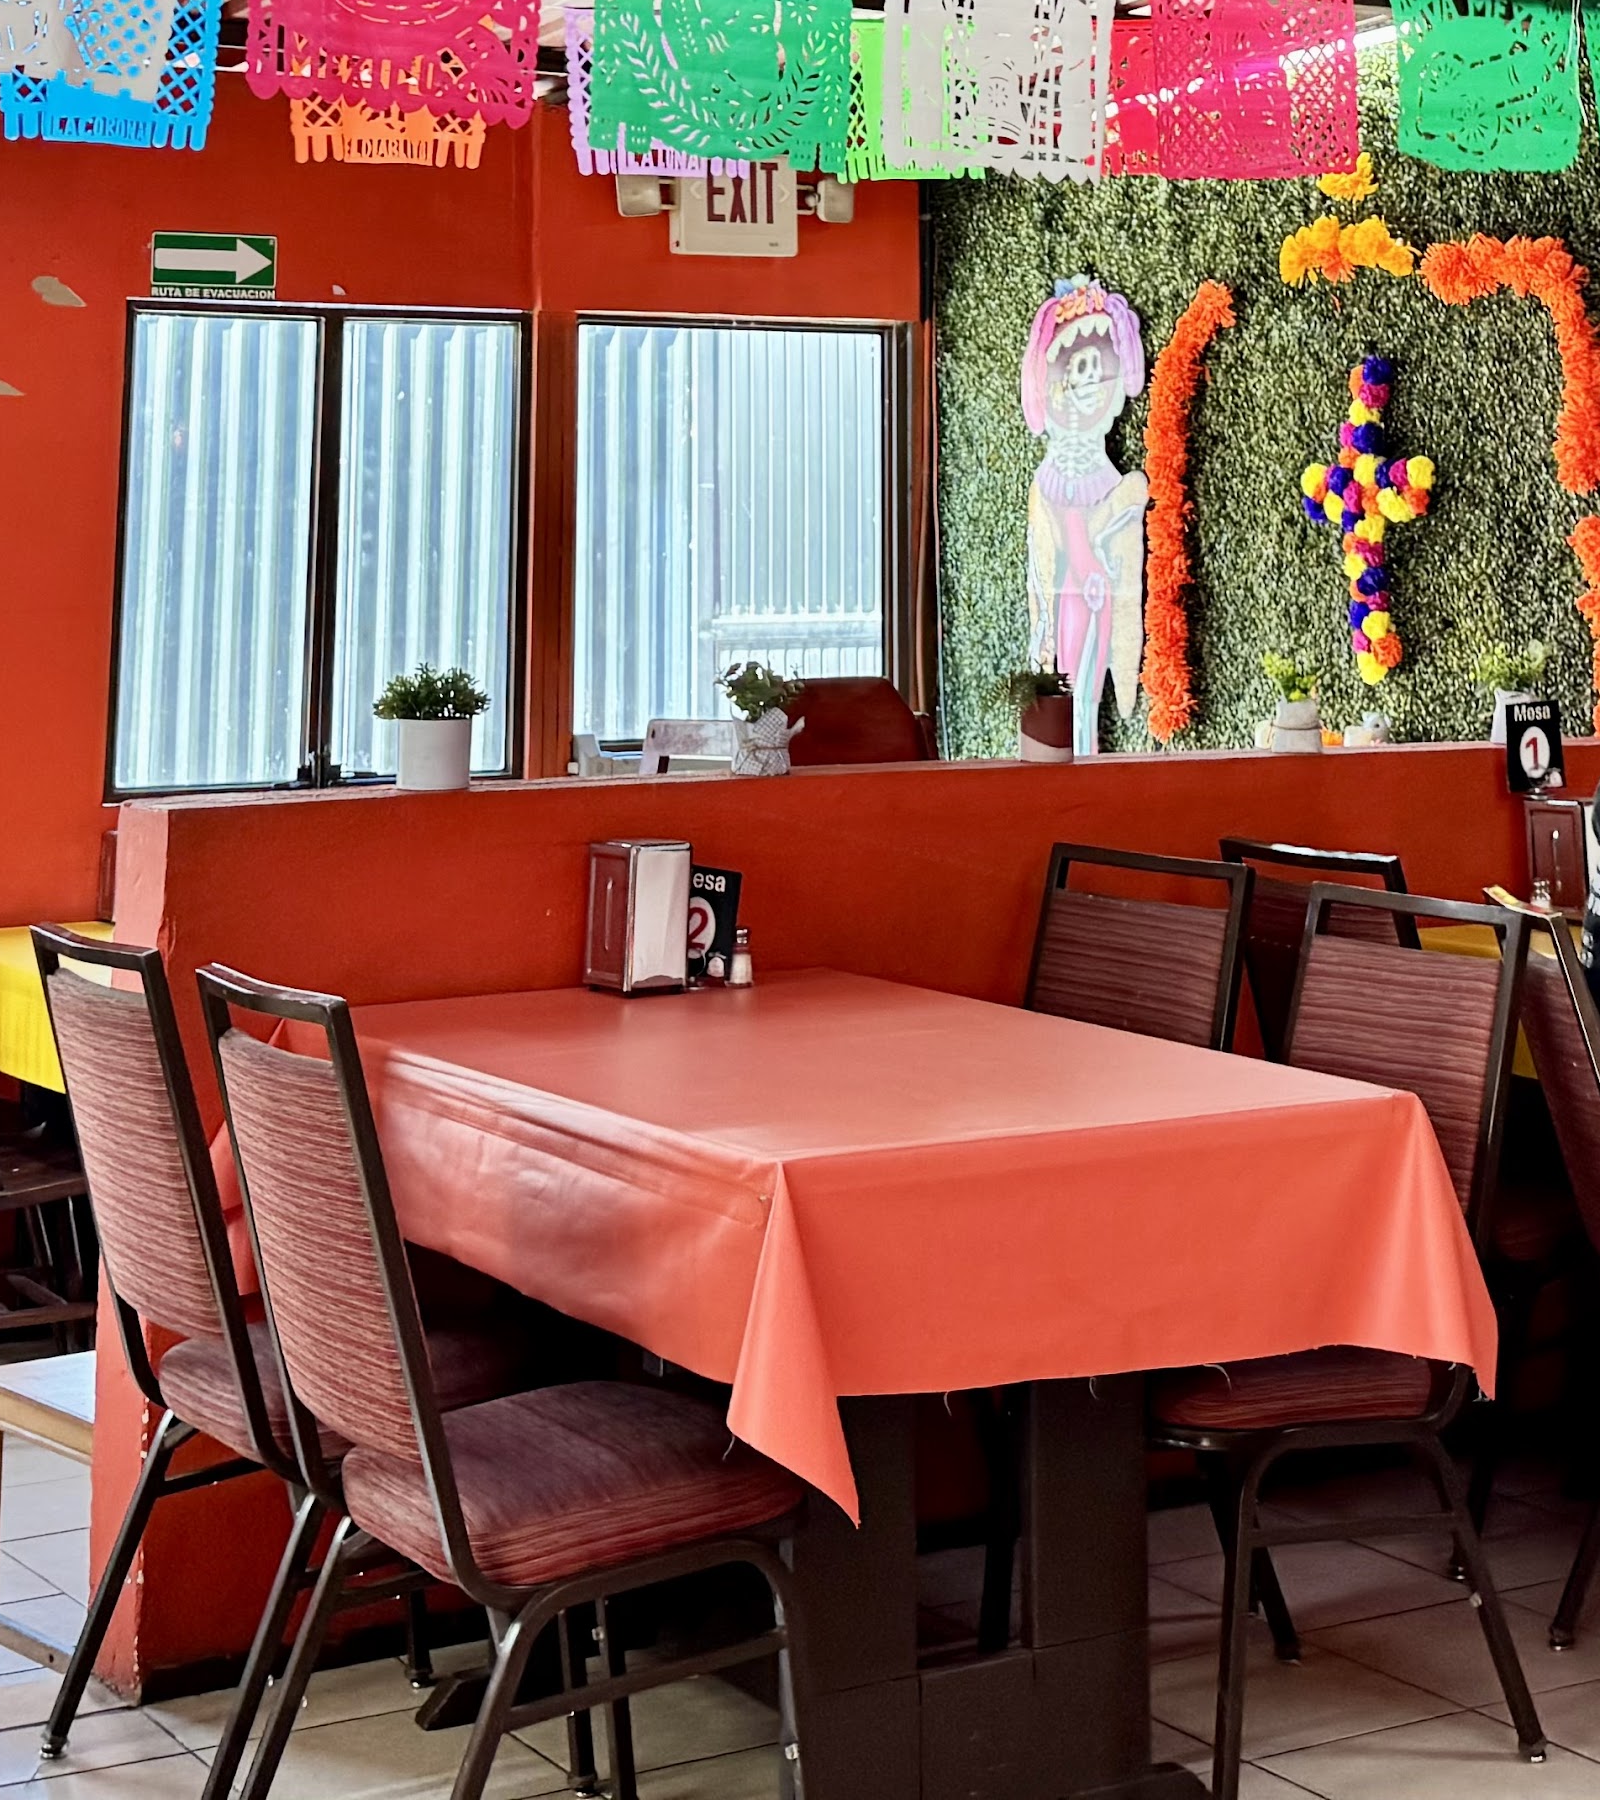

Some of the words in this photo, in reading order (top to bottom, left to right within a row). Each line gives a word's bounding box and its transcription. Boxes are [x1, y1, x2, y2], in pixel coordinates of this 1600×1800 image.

[53, 117, 81, 137] LA
[82, 116, 147, 141] CORONA
[706, 158, 779, 225] EXIT
[151, 286, 182, 297] RUTA
[184, 287, 200, 297] DE
[1525, 736, 1539, 769] 1
[692, 873, 726, 892] esa
[688, 906, 709, 950] 2
